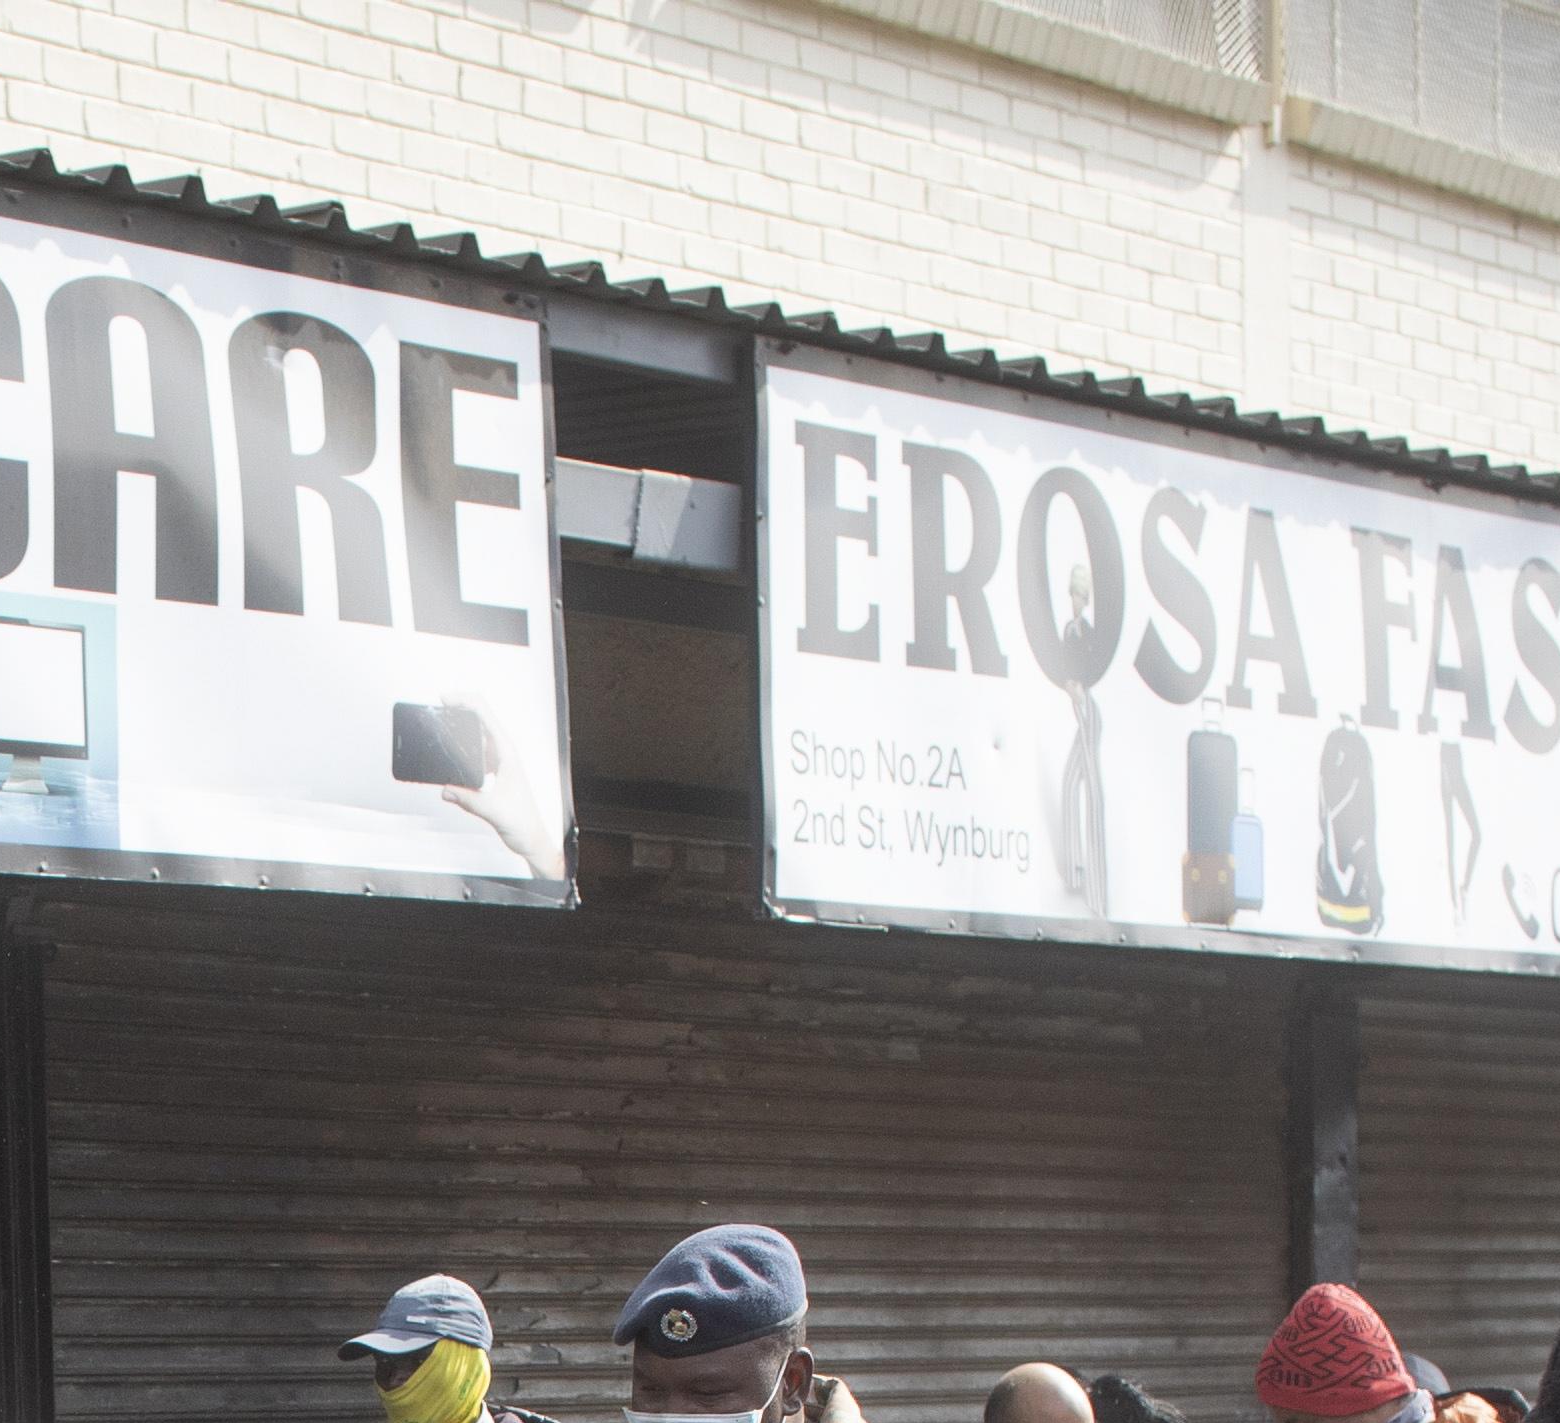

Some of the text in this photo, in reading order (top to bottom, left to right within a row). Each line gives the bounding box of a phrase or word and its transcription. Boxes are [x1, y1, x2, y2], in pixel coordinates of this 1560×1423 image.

[794, 420, 1317, 718] EROSA
[790, 729, 967, 790] Shop No.2A
[793, 799, 1031, 873] 2nd St, Wynburg
